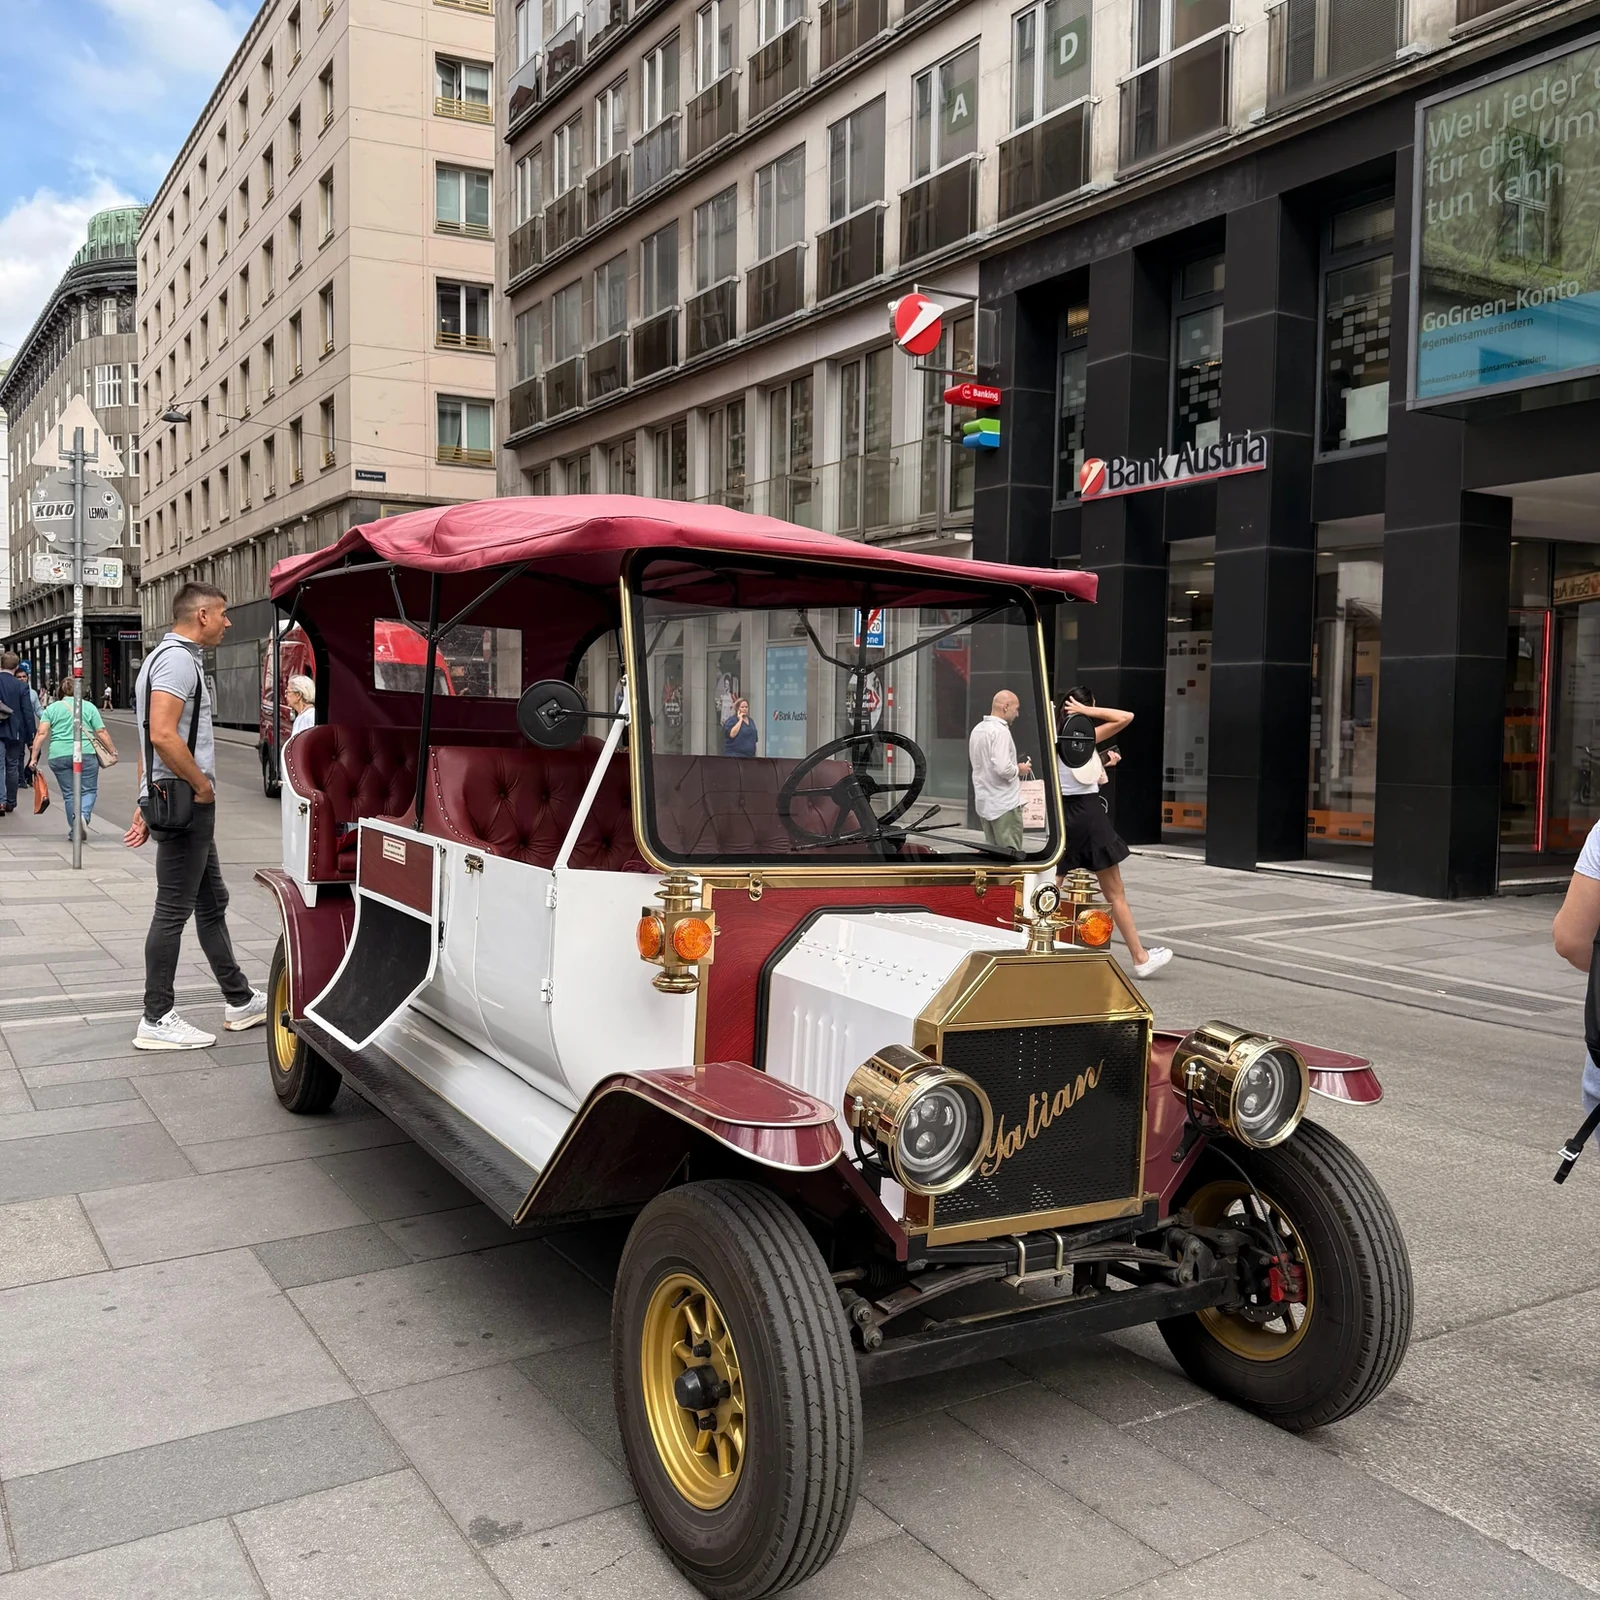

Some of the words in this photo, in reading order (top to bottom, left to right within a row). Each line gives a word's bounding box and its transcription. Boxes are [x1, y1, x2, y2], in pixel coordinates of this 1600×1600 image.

[1060, 32, 1078, 65] D
[951, 93, 968, 124] A
[1429, 99, 1492, 148] Weil
[1498, 72, 1583, 132] jeder
[1427, 151, 1468, 187] für
[1479, 133, 1525, 170] die
[1426, 190, 1474, 225] tun
[1488, 161, 1572, 207] kann.
[1422, 279, 1580, 333] GoGreen-Konto
[1421, 317, 1534, 351] #gemeinsamverändern
[973, 388, 999, 402] Banking
[1106, 447, 1170, 490] Bank
[1173, 429, 1268, 478] Austria
[35, 503, 75, 518] KOKO
[88, 507, 109, 520] LEMON
[779, 711, 791, 721] Bank
